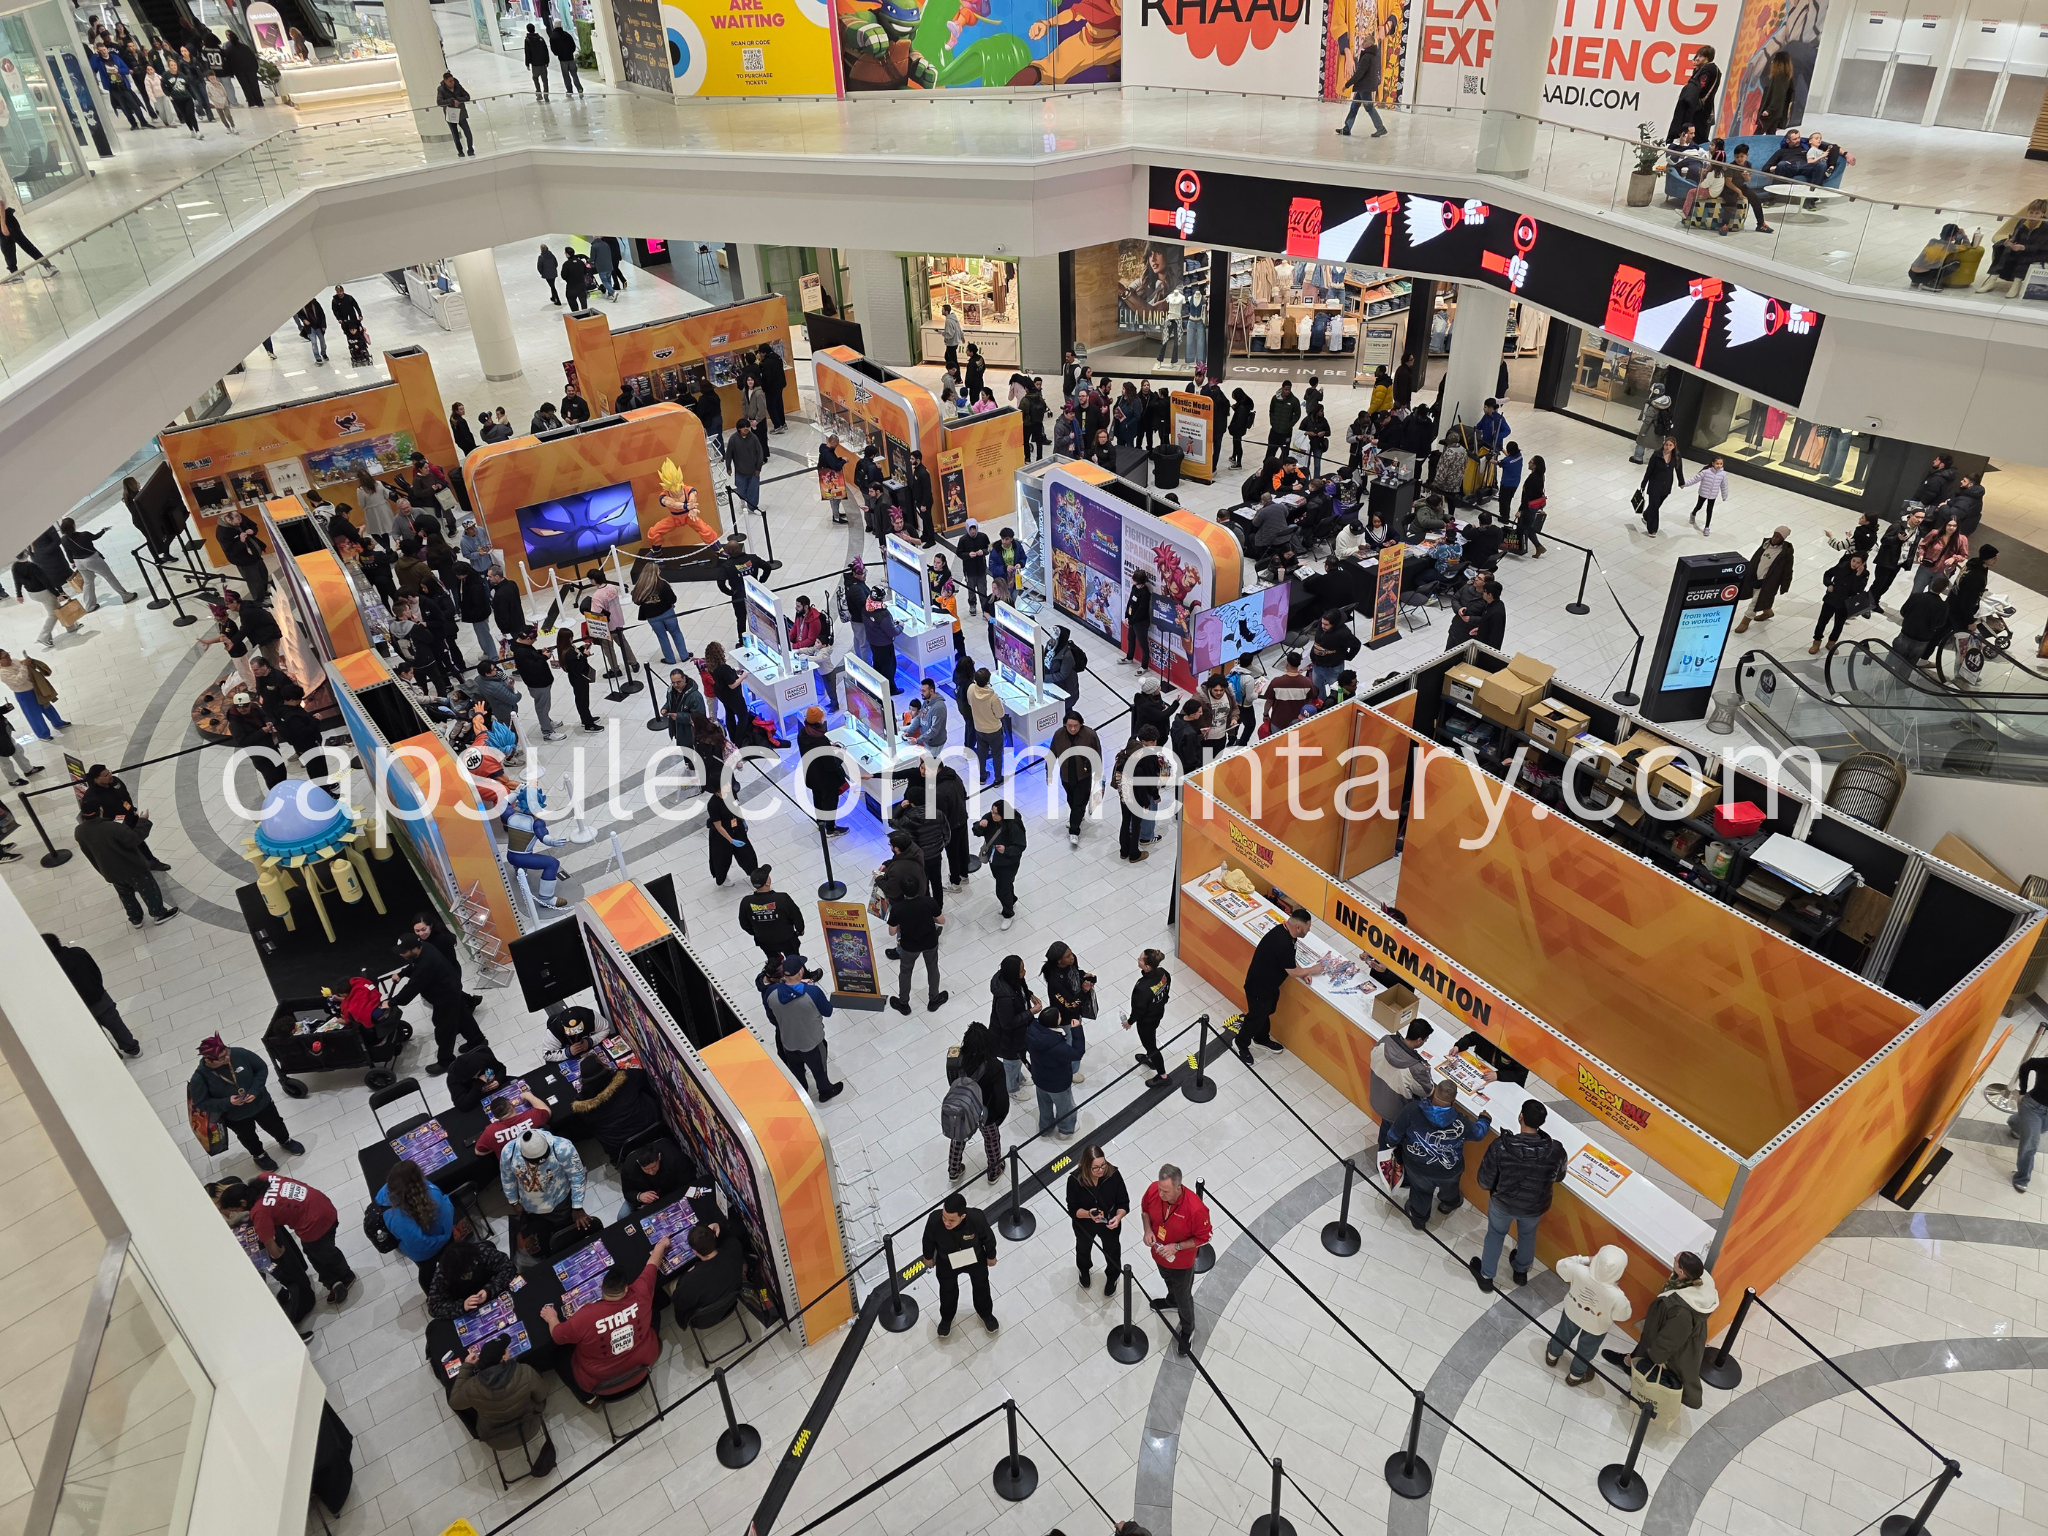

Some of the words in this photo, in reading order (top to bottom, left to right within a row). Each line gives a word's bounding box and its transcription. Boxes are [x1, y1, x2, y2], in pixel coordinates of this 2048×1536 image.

[729, 0, 763, 10] ARE
[710, 13, 785, 29] WAITING
[1422, 25, 1706, 86] EXPIENCE
[1119, 308, 1139, 324] ELLA
[1143, 310, 1168, 325] LANG
[1172, 397, 1192, 407] Plastic
[1193, 401, 1211, 411] Model
[1686, 593, 1718, 601] COURT
[928, 638, 944, 646] BANDAI
[929, 641, 944, 650] NAMCO
[787, 686, 804, 695] BANDAI
[788, 690, 805, 698] NAMCO
[1229, 820, 1258, 854] DRAGON
[1257, 844, 1274, 865] BALL
[1231, 840, 1253, 857] POP-UP
[1253, 856, 1269, 868] TOUR
[1235, 847, 1248, 858] USA
[1248, 856, 1265, 869] 2026
[348, 877, 355, 888] 1
[1335, 900, 1492, 1025] INFORMATION
[1457, 1058, 1474, 1072] Sticker
[1458, 1064, 1476, 1078] Process
[1578, 1062, 1623, 1112] DRAGON
[1622, 1102, 1651, 1128] BALL
[1579, 1086, 1614, 1112] POP-UP
[1614, 1110, 1640, 1131] TOUR
[1584, 1096, 1604, 1112] USA
[1605, 1112, 1631, 1131] 2026
[494, 1118, 534, 1143] STAFF
[1582, 1152, 1599, 1166] Sticker
[1597, 1161, 1611, 1173] Rally
[1610, 1168, 1621, 1178] Goal
[262, 1175, 281, 1206] STAFF
[293, 1186, 302, 1200] PLAY
[595, 1302, 639, 1334] STAFF
[611, 1331, 633, 1345] ORGANIZED
[615, 1338, 631, 1349] PLAY
